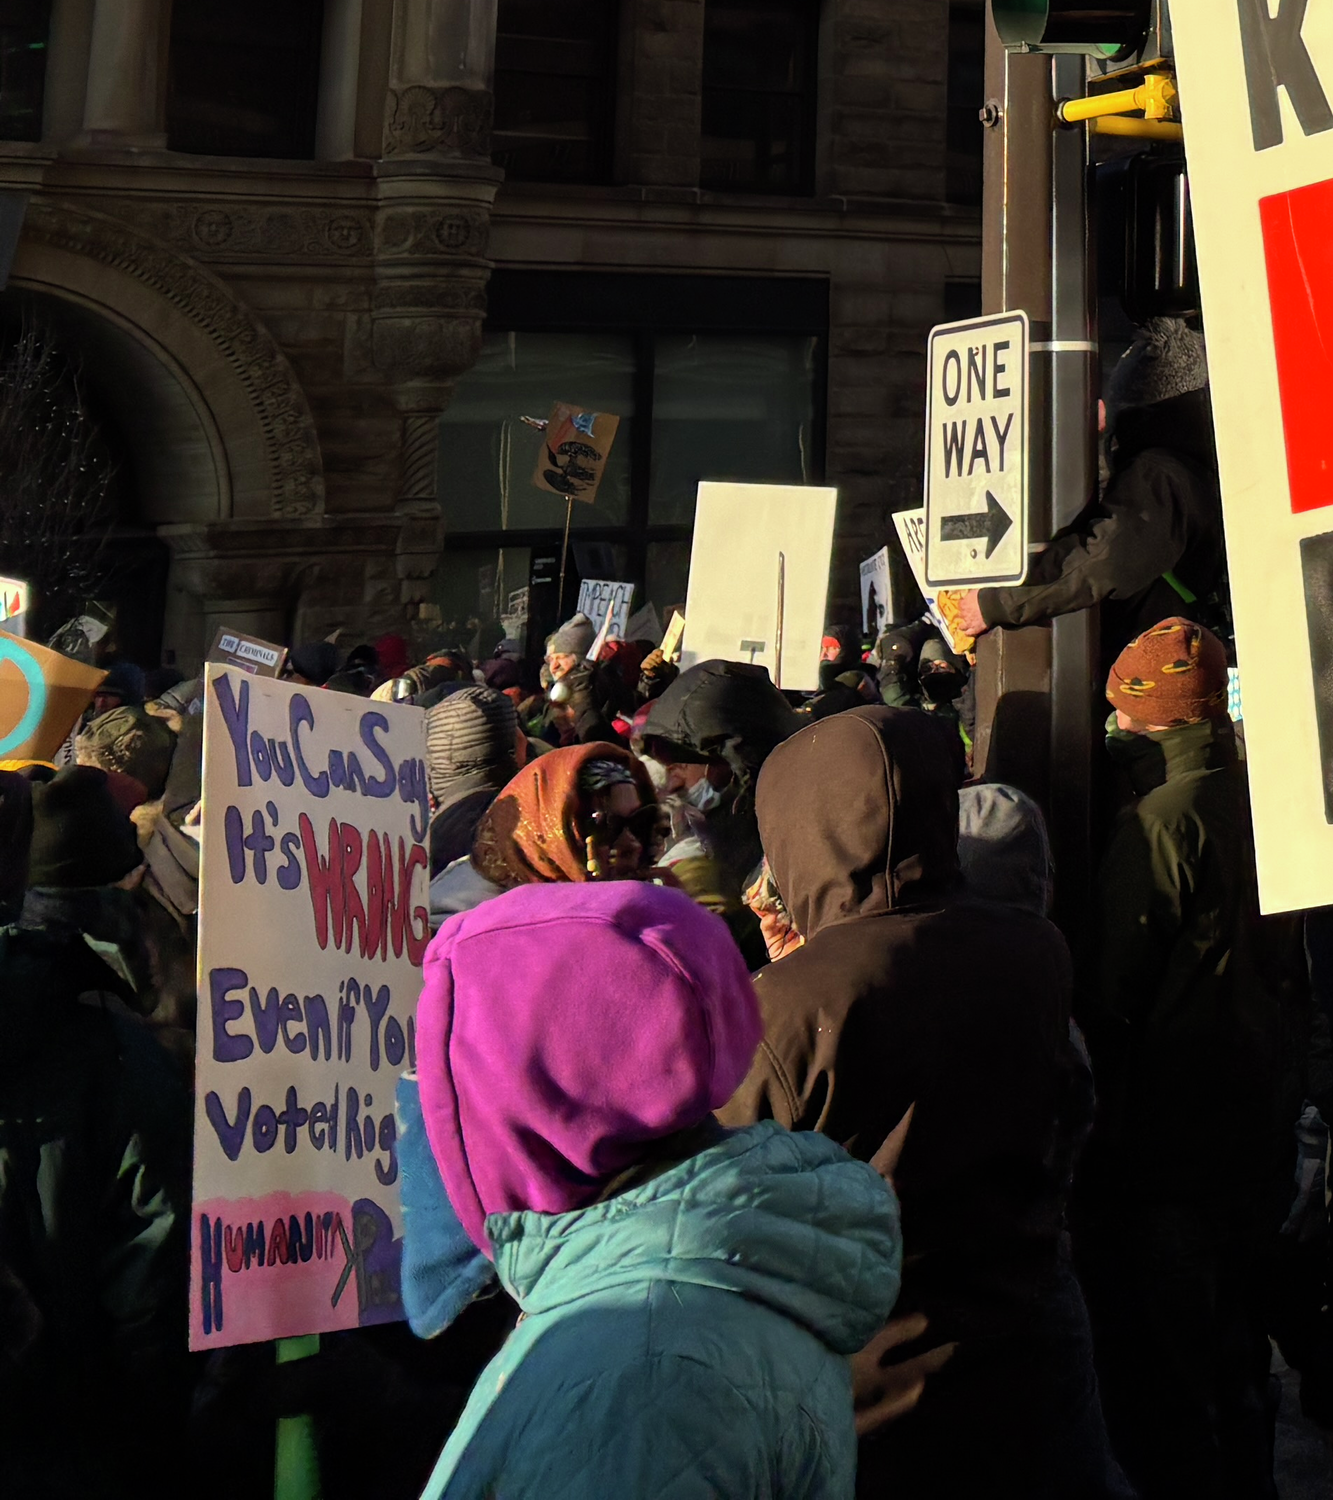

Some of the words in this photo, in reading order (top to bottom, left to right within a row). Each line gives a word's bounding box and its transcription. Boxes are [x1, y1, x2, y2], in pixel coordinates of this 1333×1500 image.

[942, 340, 1011, 407] ONE
[942, 412, 1014, 479] WAY
[212, 671, 296, 788] You
[289, 693, 368, 799] Can
[359, 711, 430, 843] Say
[224, 800, 301, 891] It's
[298, 811, 431, 968] WRONG
[209, 967, 332, 1063] Even
[337, 976, 361, 1063] if
[204, 1081, 340, 1162] Voted
[345, 1085, 398, 1186] Rig
